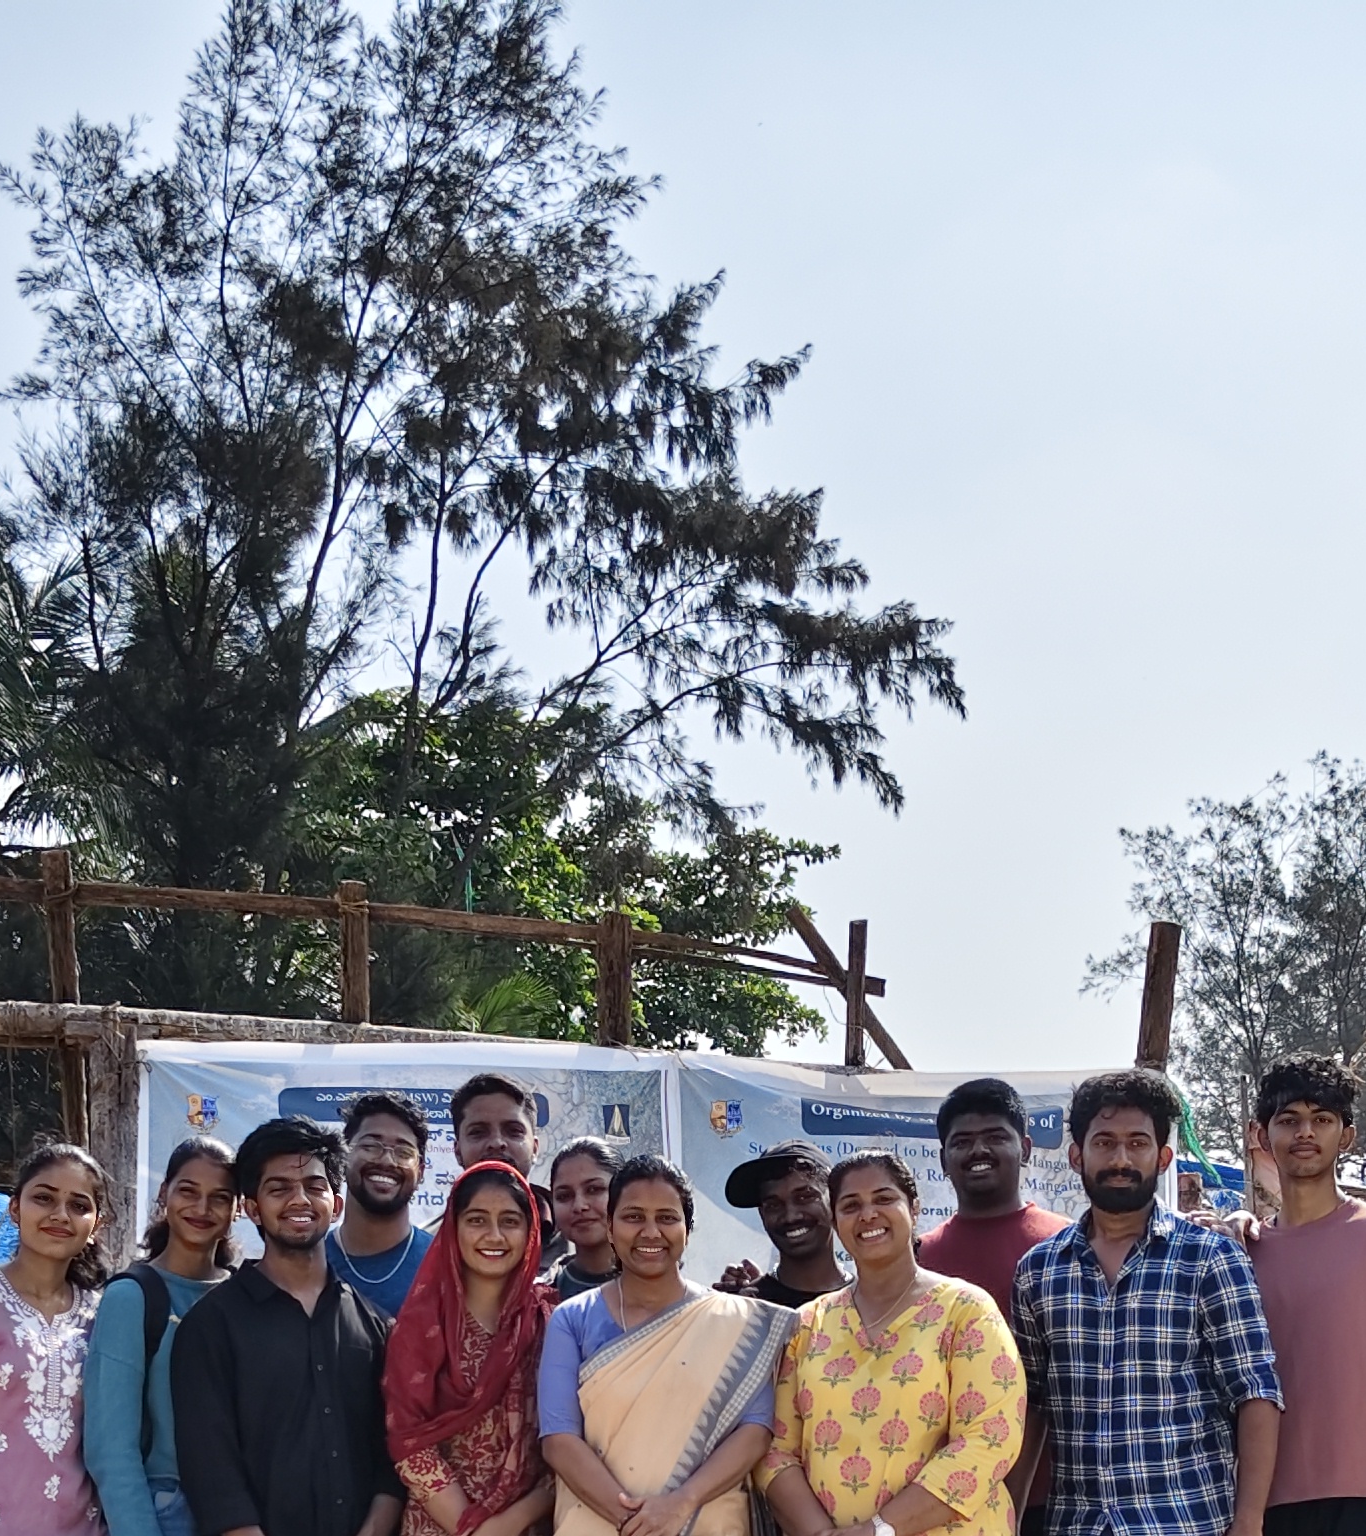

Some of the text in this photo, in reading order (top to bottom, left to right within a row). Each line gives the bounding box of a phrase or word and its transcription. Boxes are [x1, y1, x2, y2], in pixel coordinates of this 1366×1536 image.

[811, 1103, 891, 1120] Organized
[1040, 1113, 1056, 1130] of
[904, 1145, 917, 1157] to
